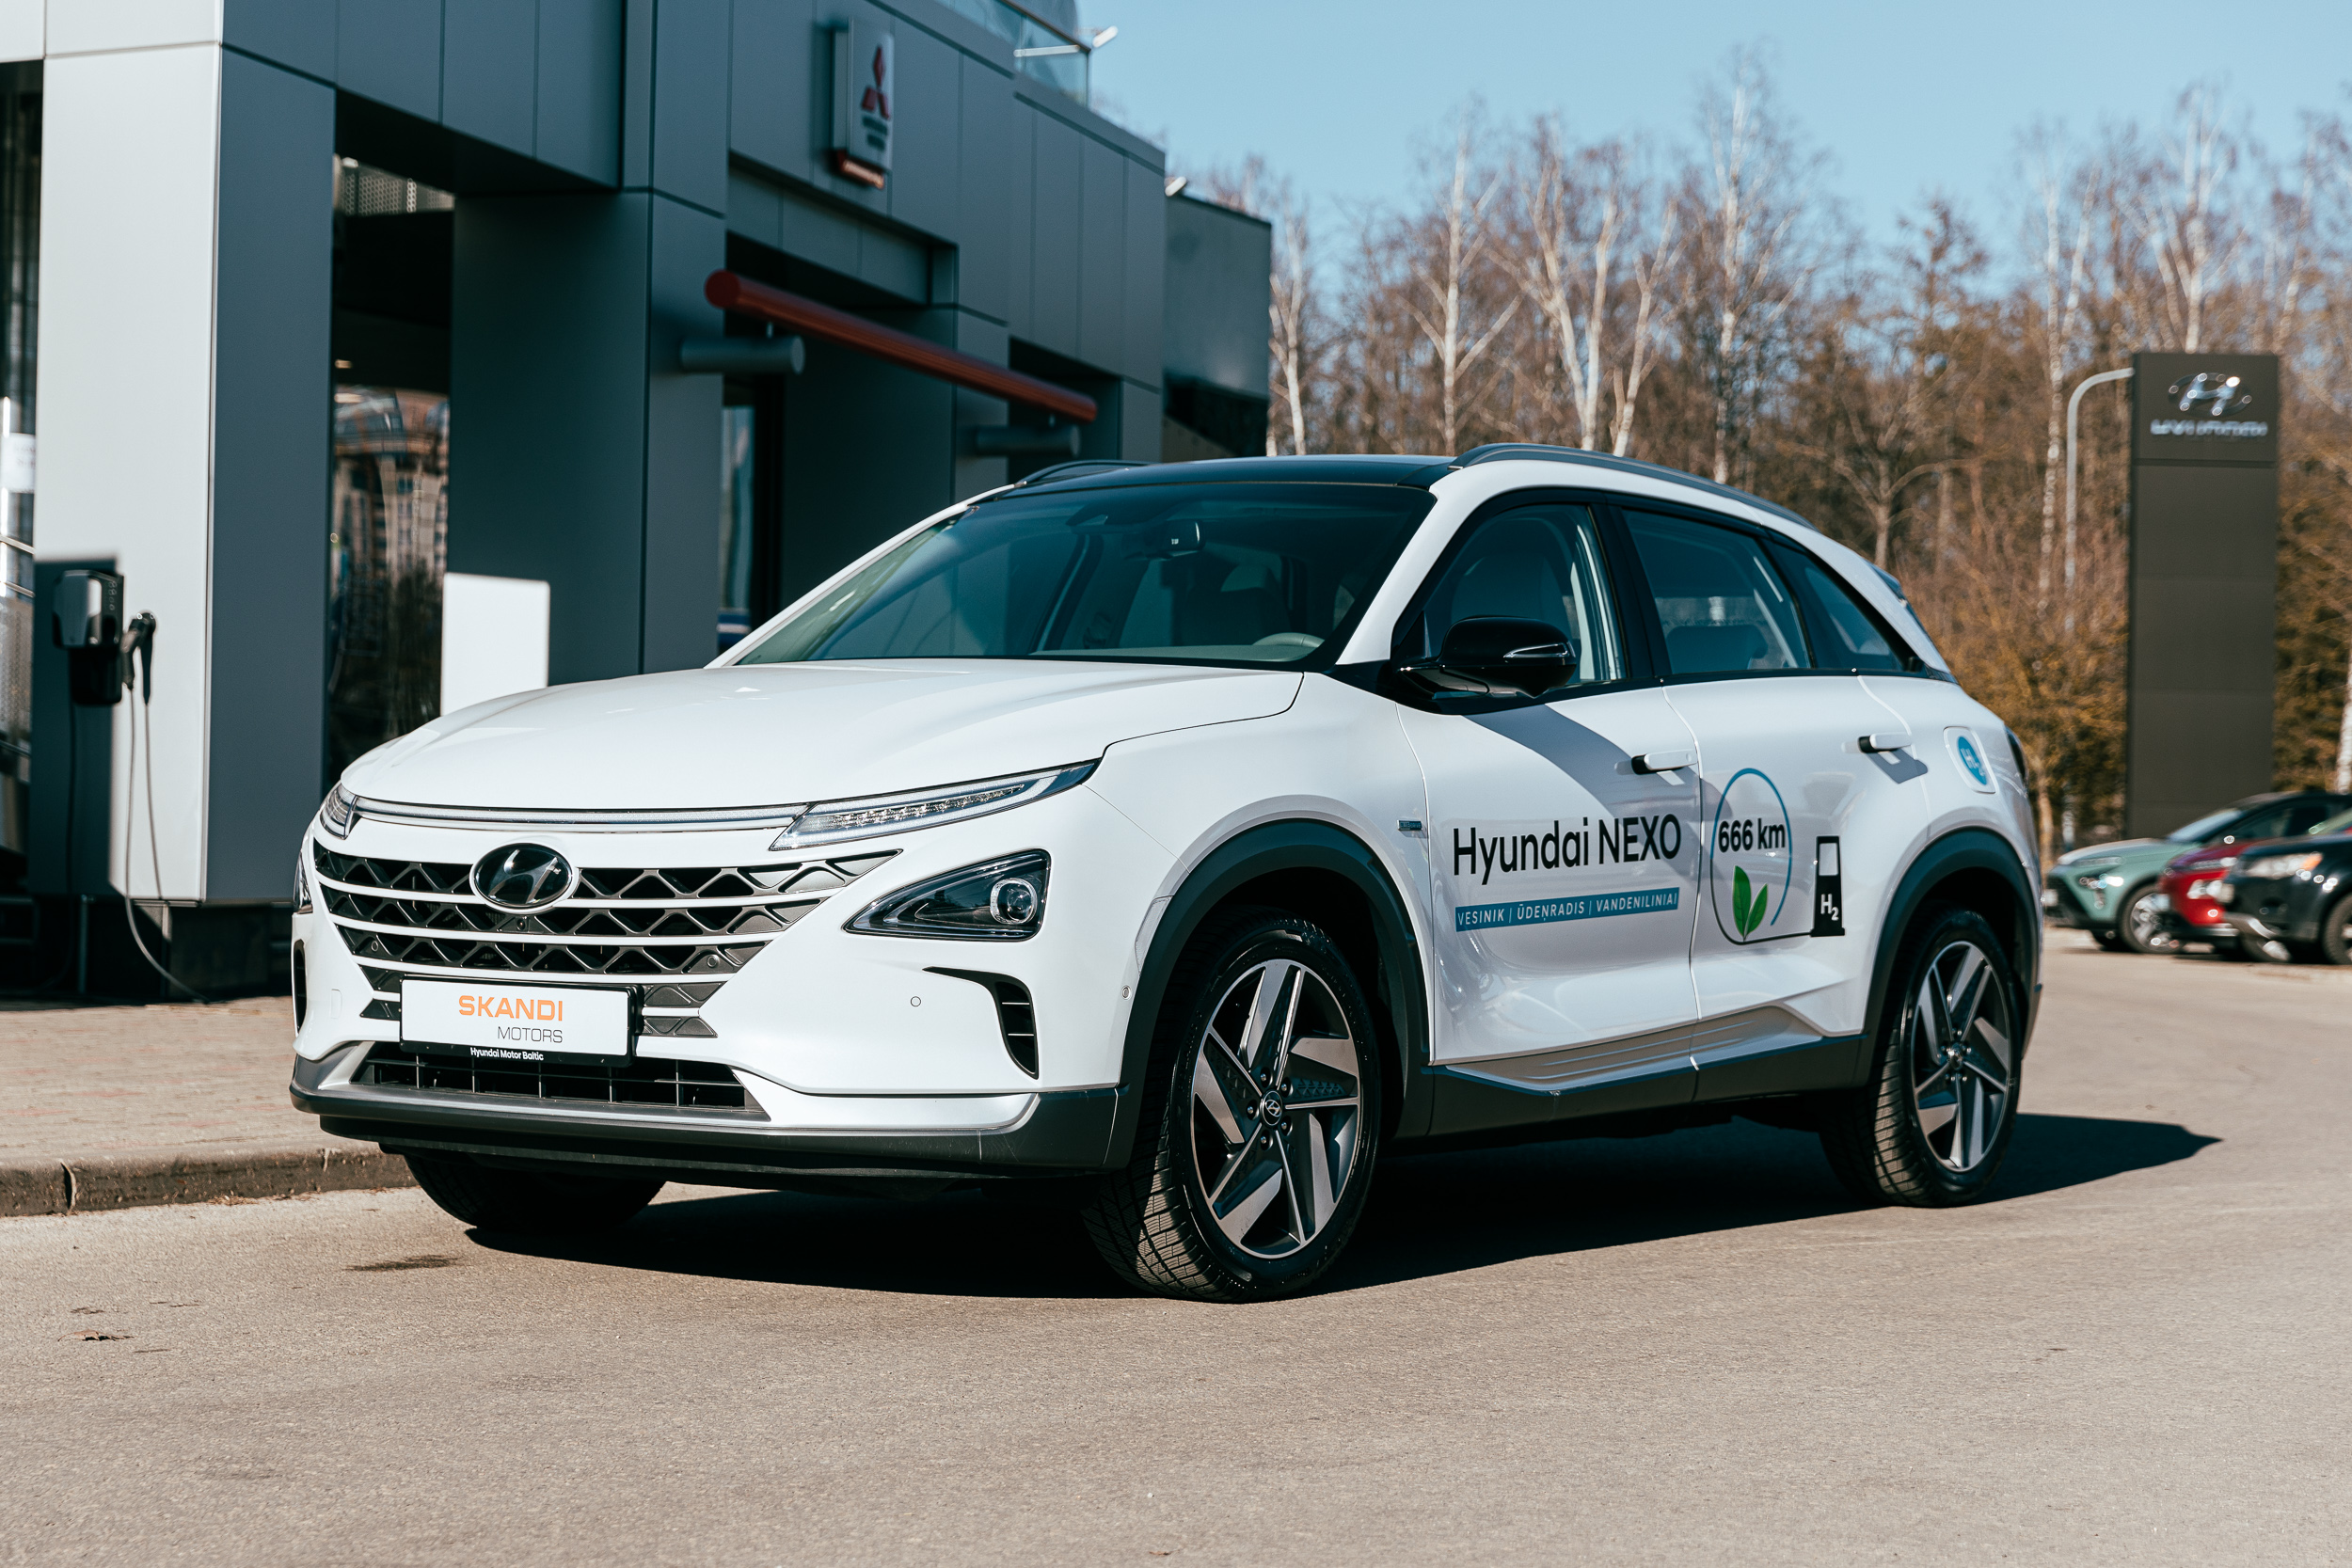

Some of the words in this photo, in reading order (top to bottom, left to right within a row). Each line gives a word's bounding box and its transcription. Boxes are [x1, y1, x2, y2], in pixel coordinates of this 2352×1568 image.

[1718, 819, 1754, 853] 666
[1757, 817, 1786, 849] km
[1453, 816, 1589, 885] Hyundai
[1598, 814, 1682, 864] NEXO
[1457, 908, 1505, 927] VESINIK
[1517, 900, 1585, 922] ŪDEŅRADIS
[1596, 892, 1678, 913] VANDENILINIAI
[1820, 894, 1839, 921] H2
[458, 994, 564, 1022] SKANDI
[497, 1025, 564, 1044] MOTORS
[469, 1047, 500, 1058] Hyundai
[500, 1049, 521, 1059] Motor
[522, 1051, 545, 1061] Baltic
